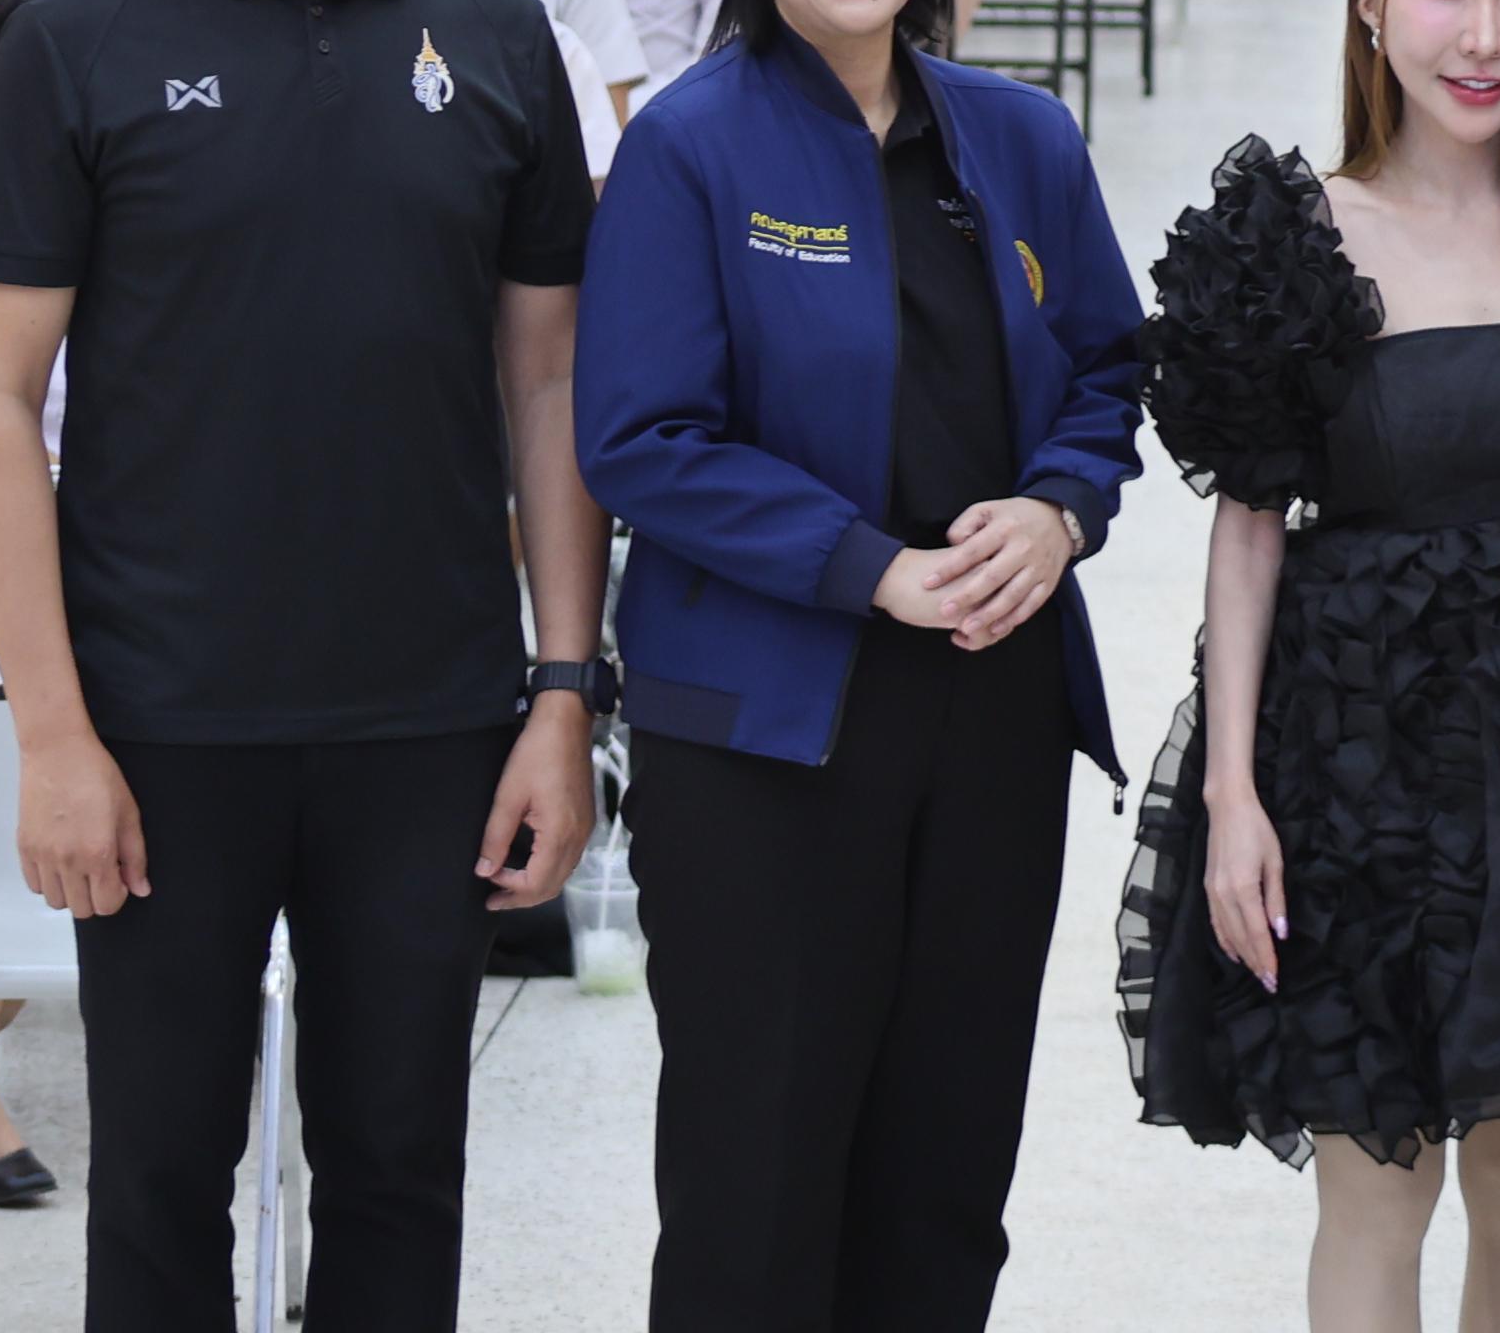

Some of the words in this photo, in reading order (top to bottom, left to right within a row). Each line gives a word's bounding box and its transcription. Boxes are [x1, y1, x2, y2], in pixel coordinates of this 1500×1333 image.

[748, 237, 784, 255] Faculty
[784, 248, 796, 257] of
[798, 250, 851, 263] Education
